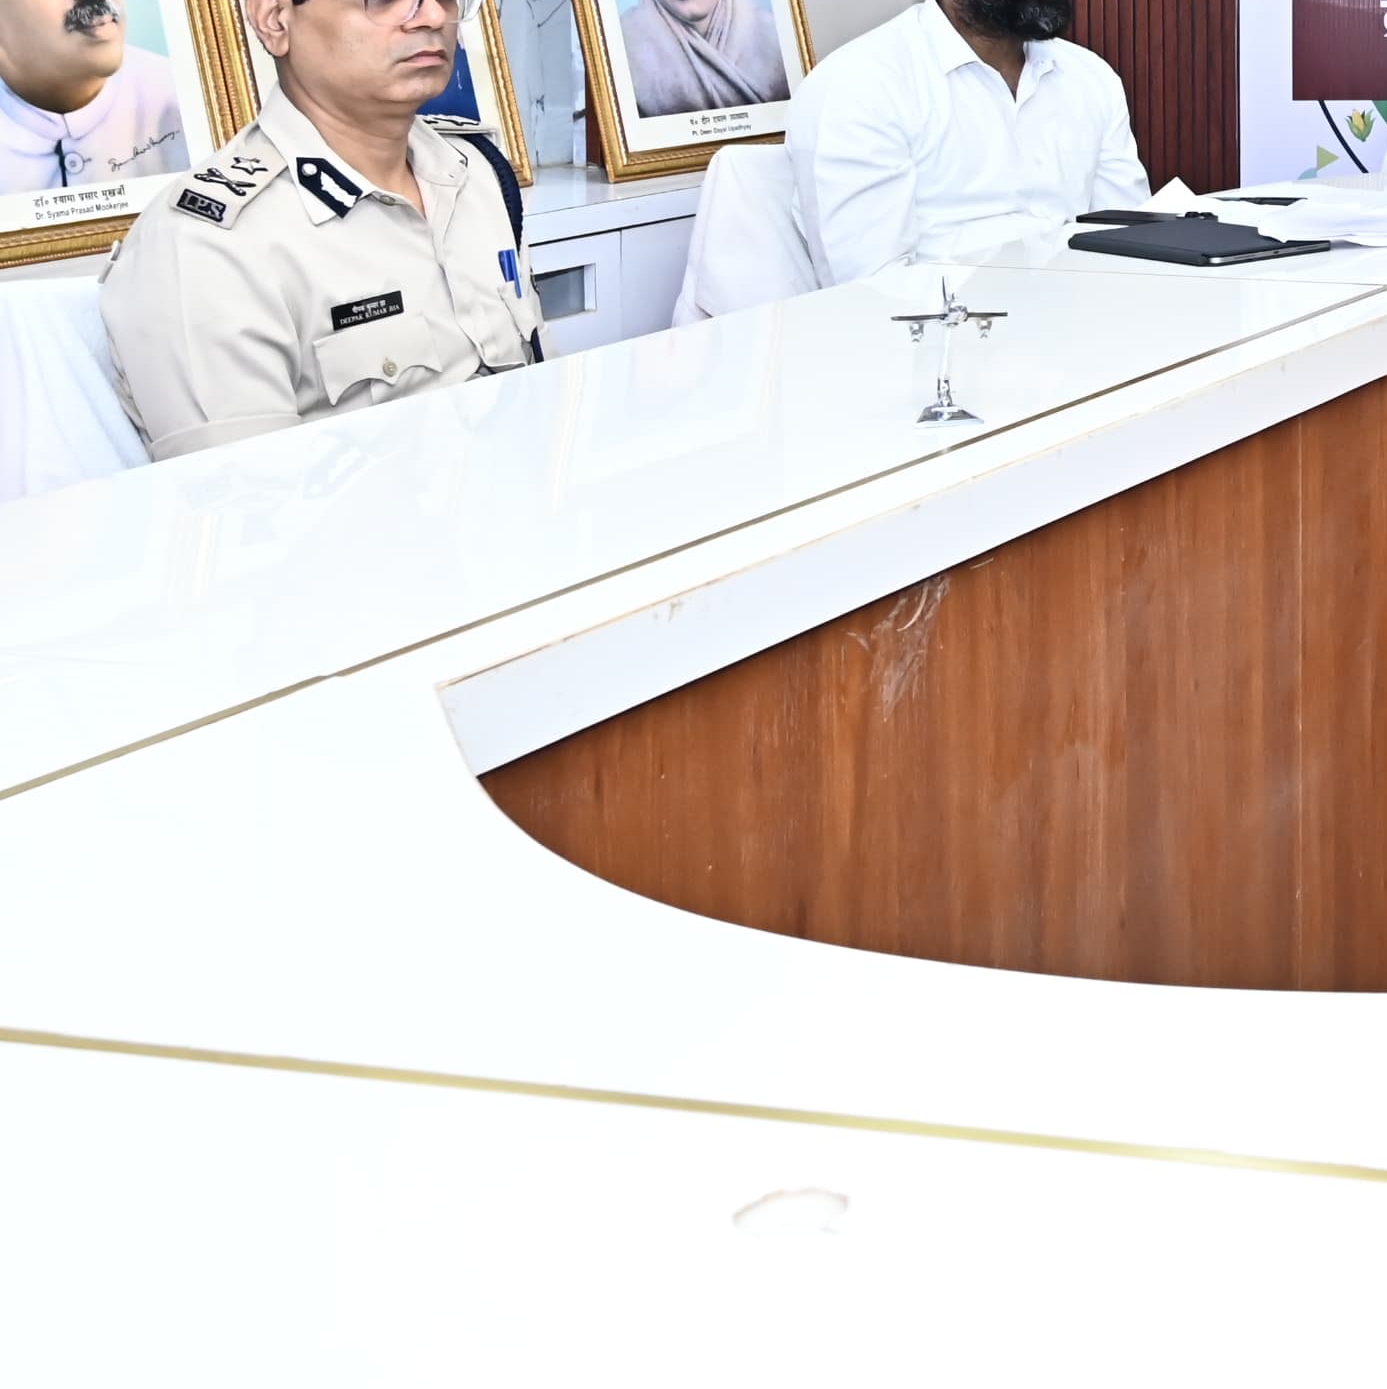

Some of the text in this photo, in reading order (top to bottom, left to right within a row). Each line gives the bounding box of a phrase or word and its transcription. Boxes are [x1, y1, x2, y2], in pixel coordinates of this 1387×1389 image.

[53, 194, 76, 205] श्यामा
[78, 191, 98, 202] प्रसाद
[47, 209, 70, 220] Syama
[71, 206, 95, 215] Prasad
[95, 201, 129, 212] Mookerjee
[339, 314, 364, 325] DEEPAK
